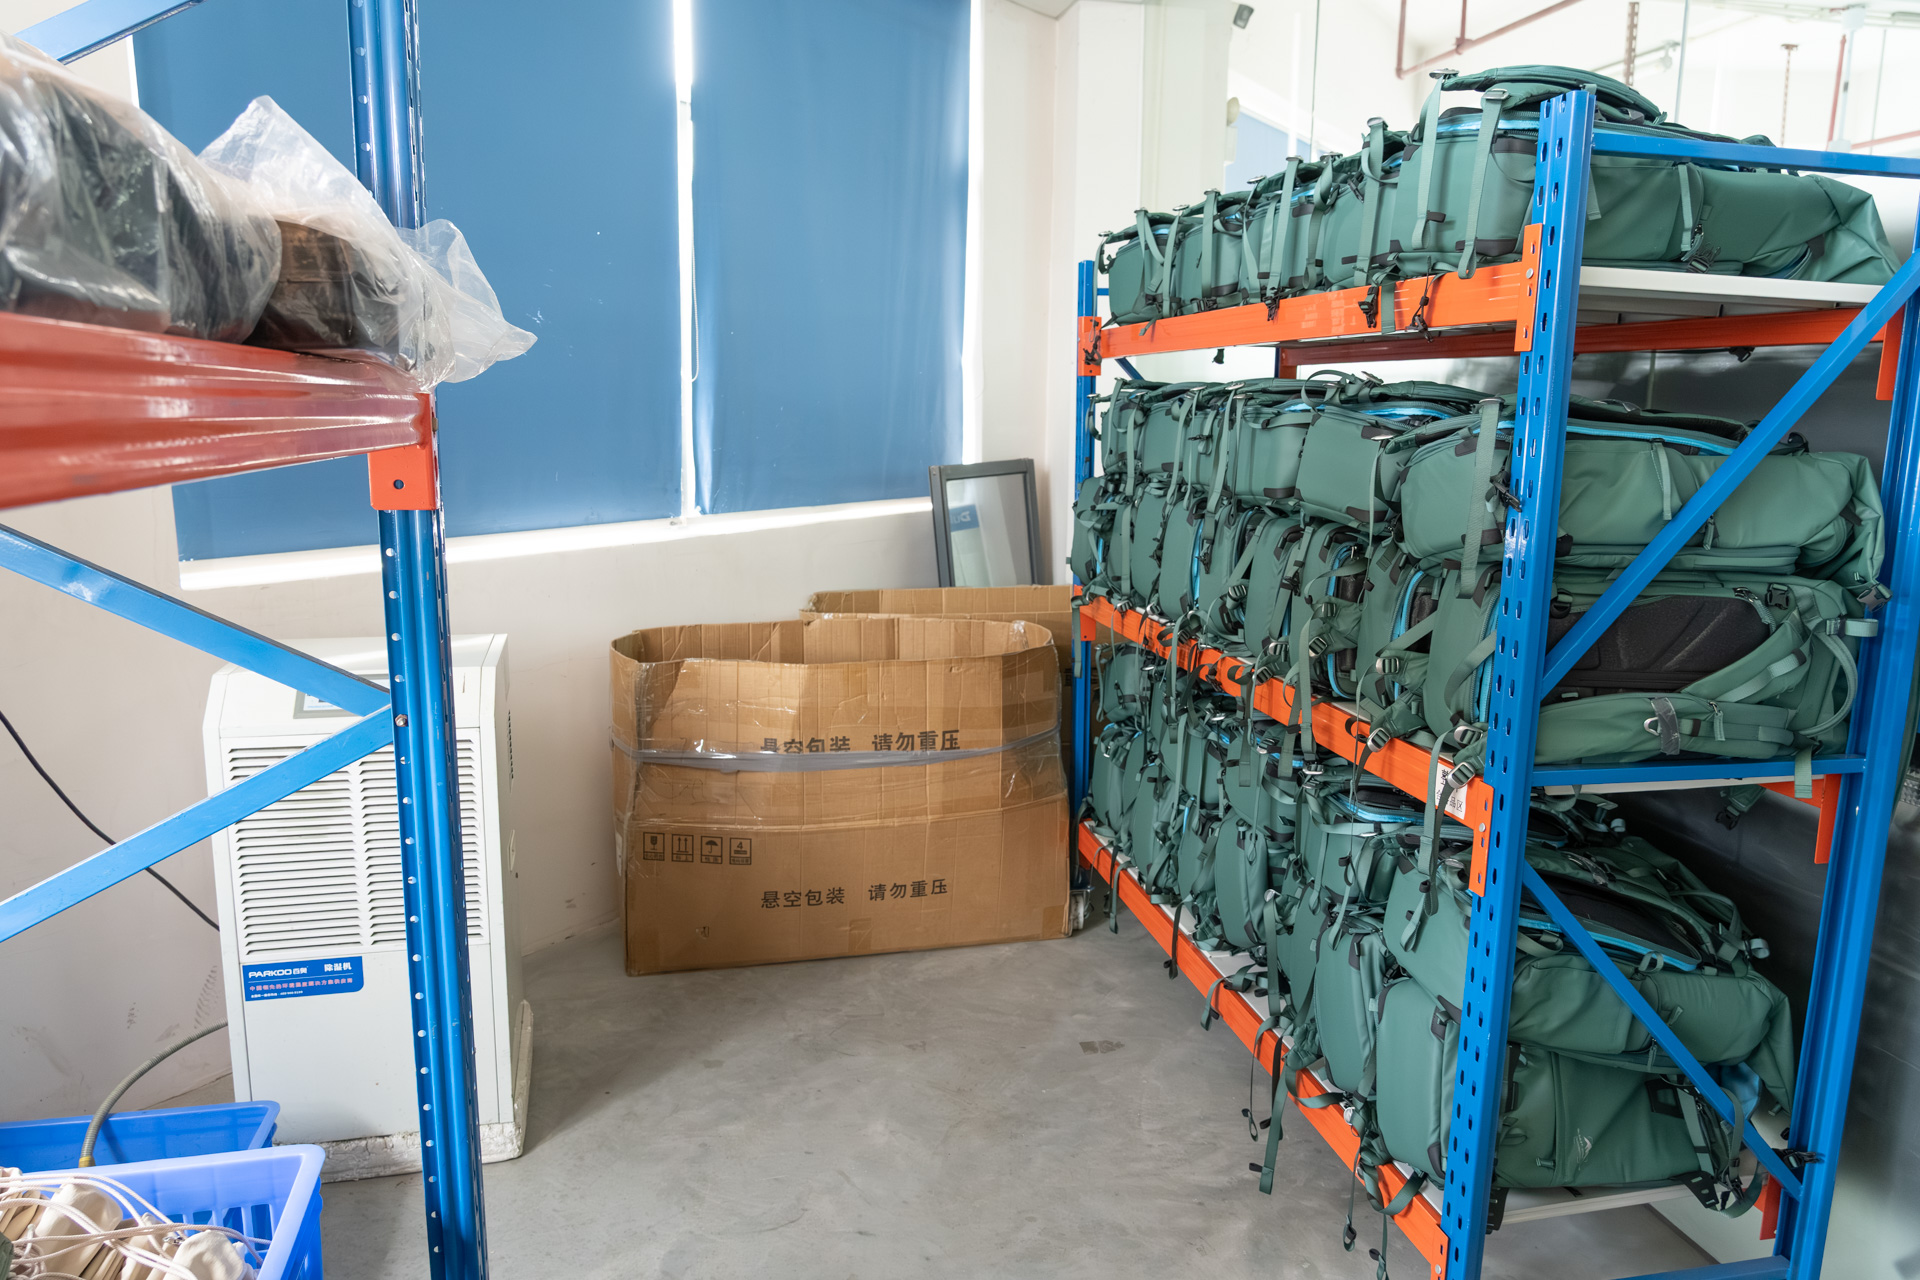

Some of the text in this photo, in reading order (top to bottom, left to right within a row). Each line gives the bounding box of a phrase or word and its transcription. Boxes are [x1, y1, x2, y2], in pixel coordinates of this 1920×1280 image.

[872, 729, 960, 751] 请勿重压
[761, 878, 948, 909] 悬空包装 请勿重压
[248, 968, 292, 978] PARKOO
[324, 962, 352, 972] 除湿机
